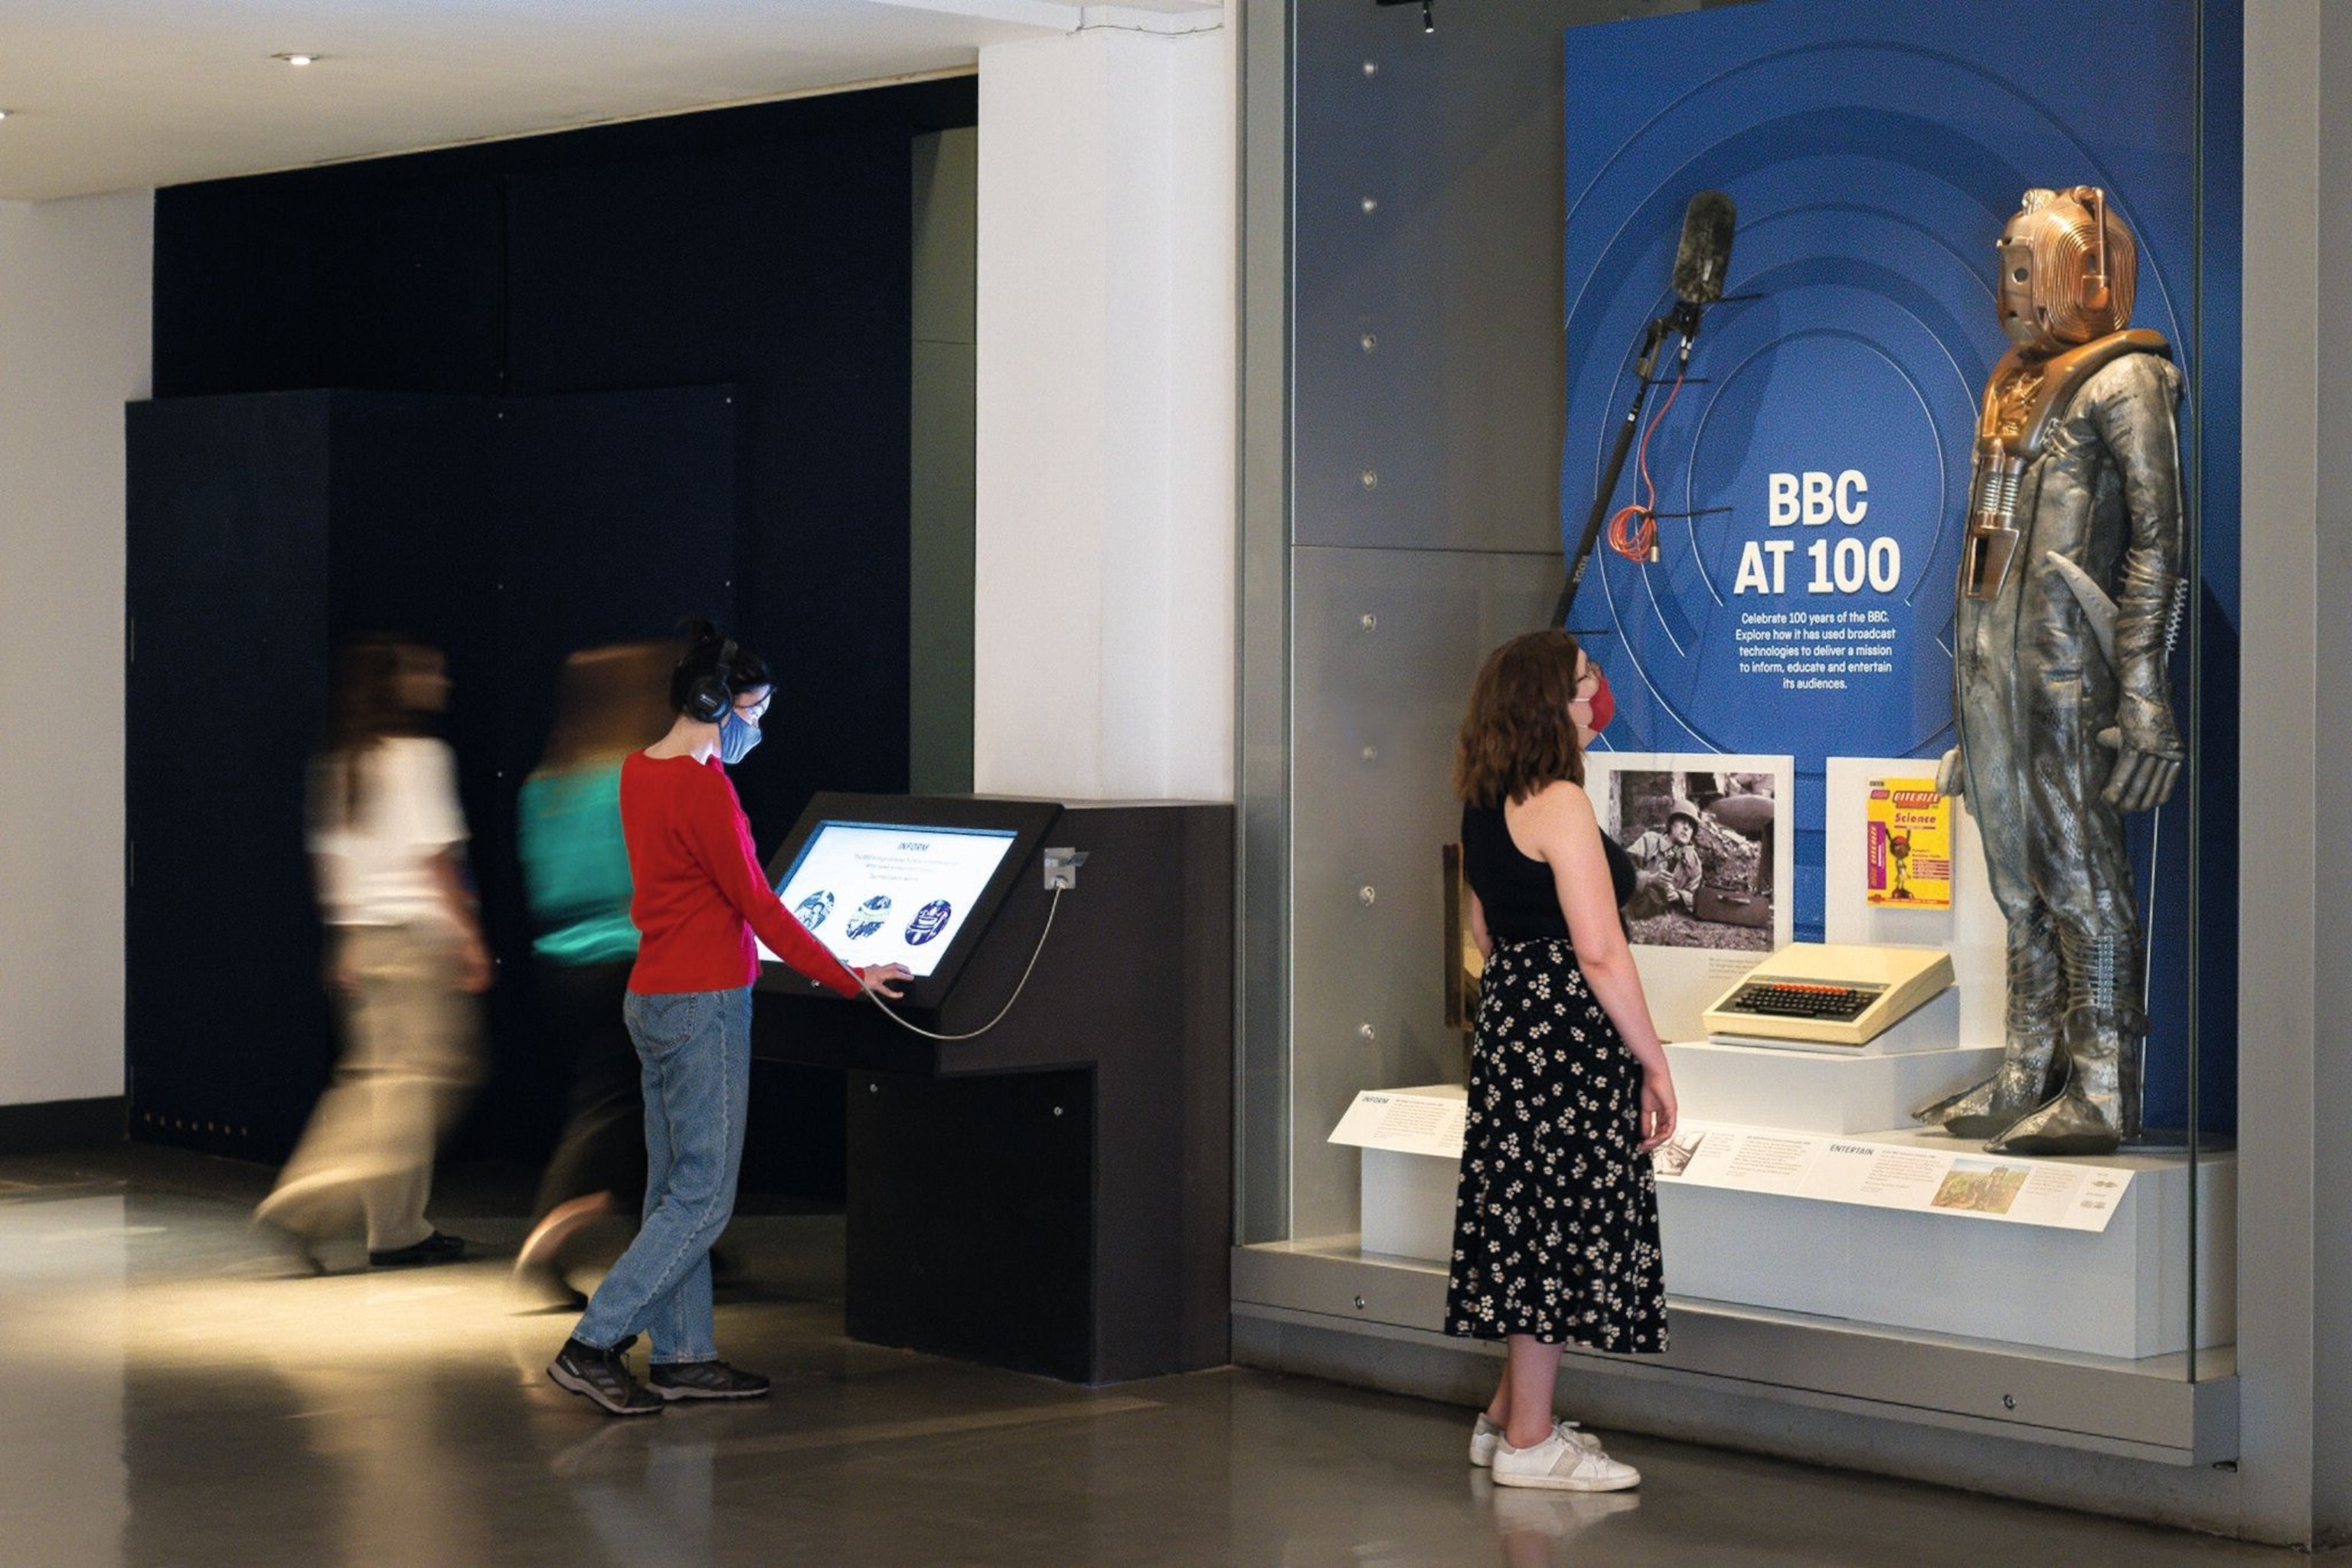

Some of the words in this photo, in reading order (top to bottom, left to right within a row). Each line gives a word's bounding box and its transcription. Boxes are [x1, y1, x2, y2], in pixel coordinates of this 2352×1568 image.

[1769, 469, 1868, 527] BBC
[1733, 540, 1795, 594] AT
[1808, 537, 1901, 593] 100
[1741, 612, 1788, 624] Celebrate
[1789, 612, 1808, 623] 100
[1809, 613, 1835, 626] years
[1837, 611, 1847, 622] of
[1849, 611, 1866, 623] the
[1867, 610, 1890, 622] BBC.
[1736, 629, 1771, 642] Explore
[1772, 628, 1792, 640] how
[1794, 628, 1802, 640] it
[1803, 628, 1821, 640] has
[1822, 628, 1845, 639] used
[1847, 628, 1896, 639] broadcast
[1739, 645, 1799, 658] technologies
[1801, 645, 1811, 656] to
[1813, 644, 1846, 656] deliver
[1847, 646, 1854, 656] a
[1856, 644, 1893, 655] mission
[1739, 662, 1749, 672] to
[1752, 661, 1785, 673] inform,
[1786, 661, 1826, 673] educate
[1828, 661, 1846, 672] and
[1847, 661, 1893, 672] entertain
[1782, 677, 1795, 689] its
[1796, 677, 1847, 689] audiences.
[1895, 812, 1936, 824] Science
[897, 841, 930, 851] INFORM
[1362, 1096, 1390, 1104] INFORM
[1829, 1144, 1875, 1156] ENTERTAIN
